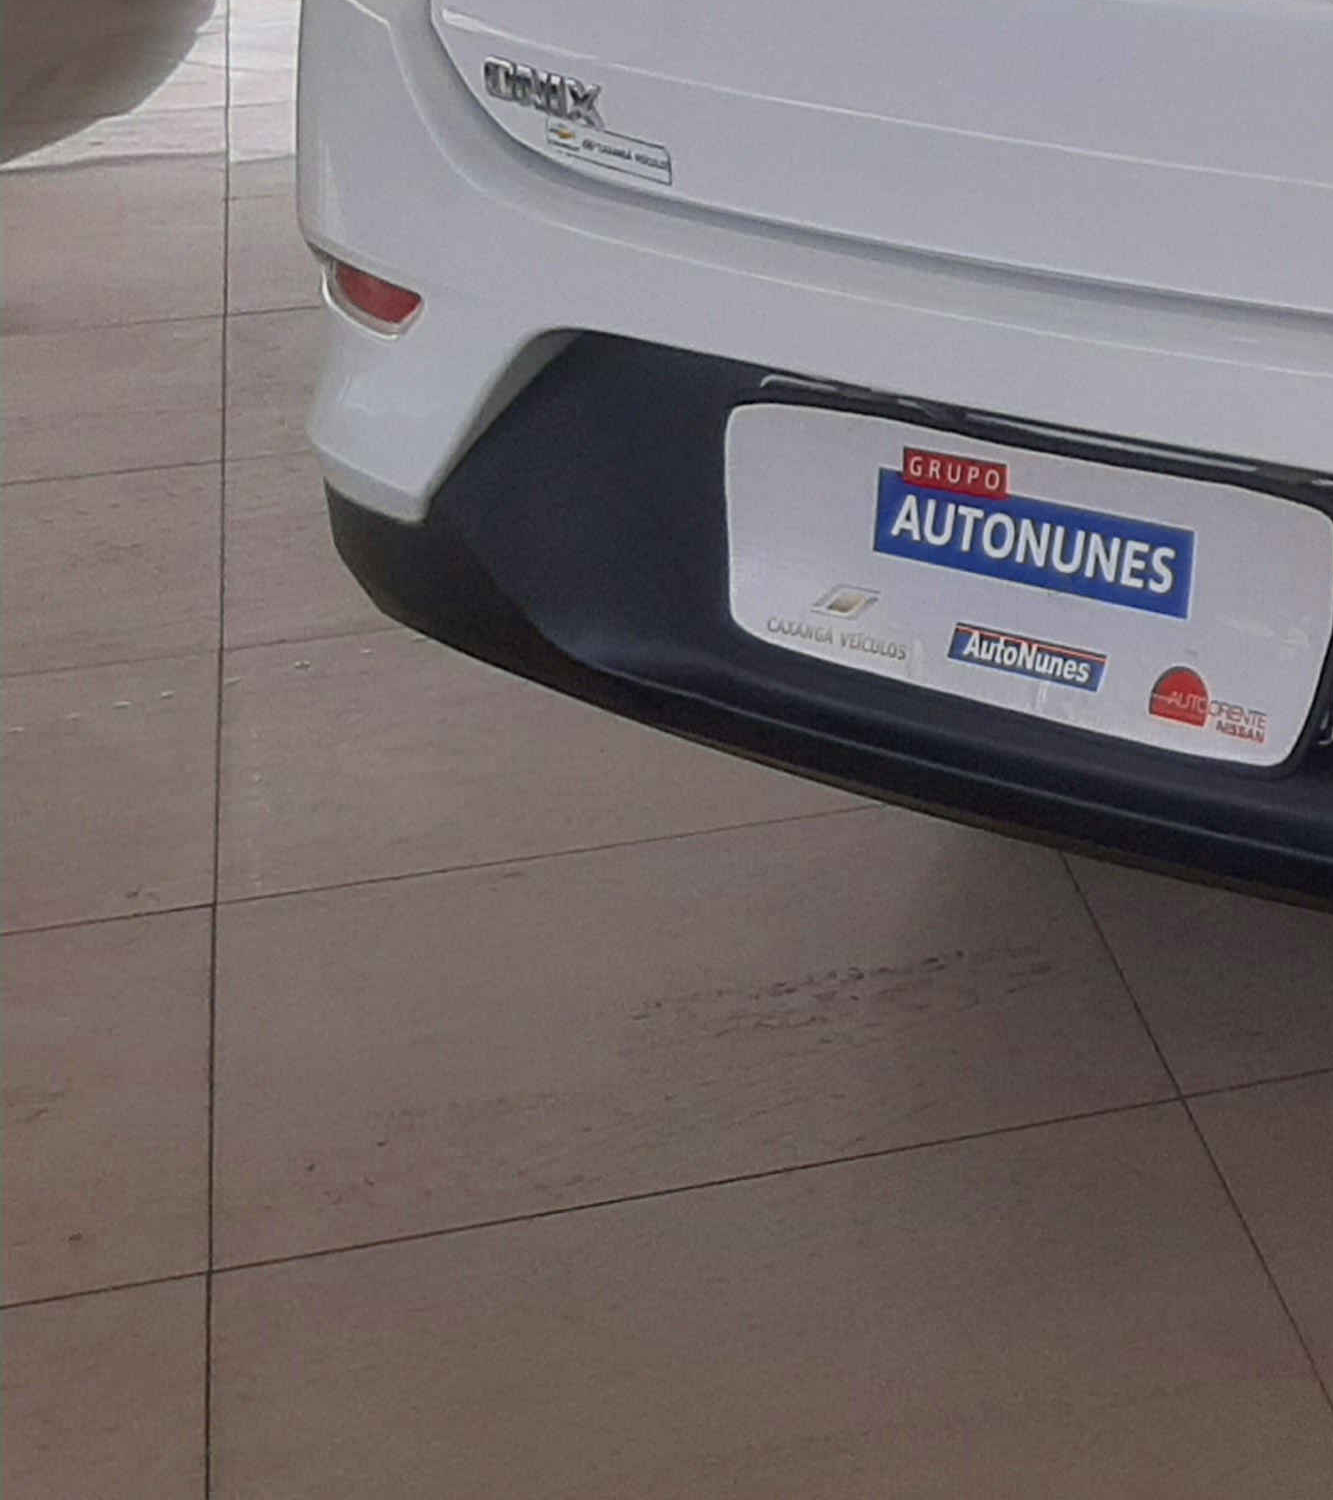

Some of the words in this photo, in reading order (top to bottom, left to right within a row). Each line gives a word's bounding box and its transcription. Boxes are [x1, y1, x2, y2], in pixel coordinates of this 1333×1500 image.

[909, 456, 1000, 490] GRUPO
[891, 495, 1176, 594] AUTONUNES
[963, 630, 1092, 683] AutoNunes
[1215, 720, 1266, 744] NISSAN
